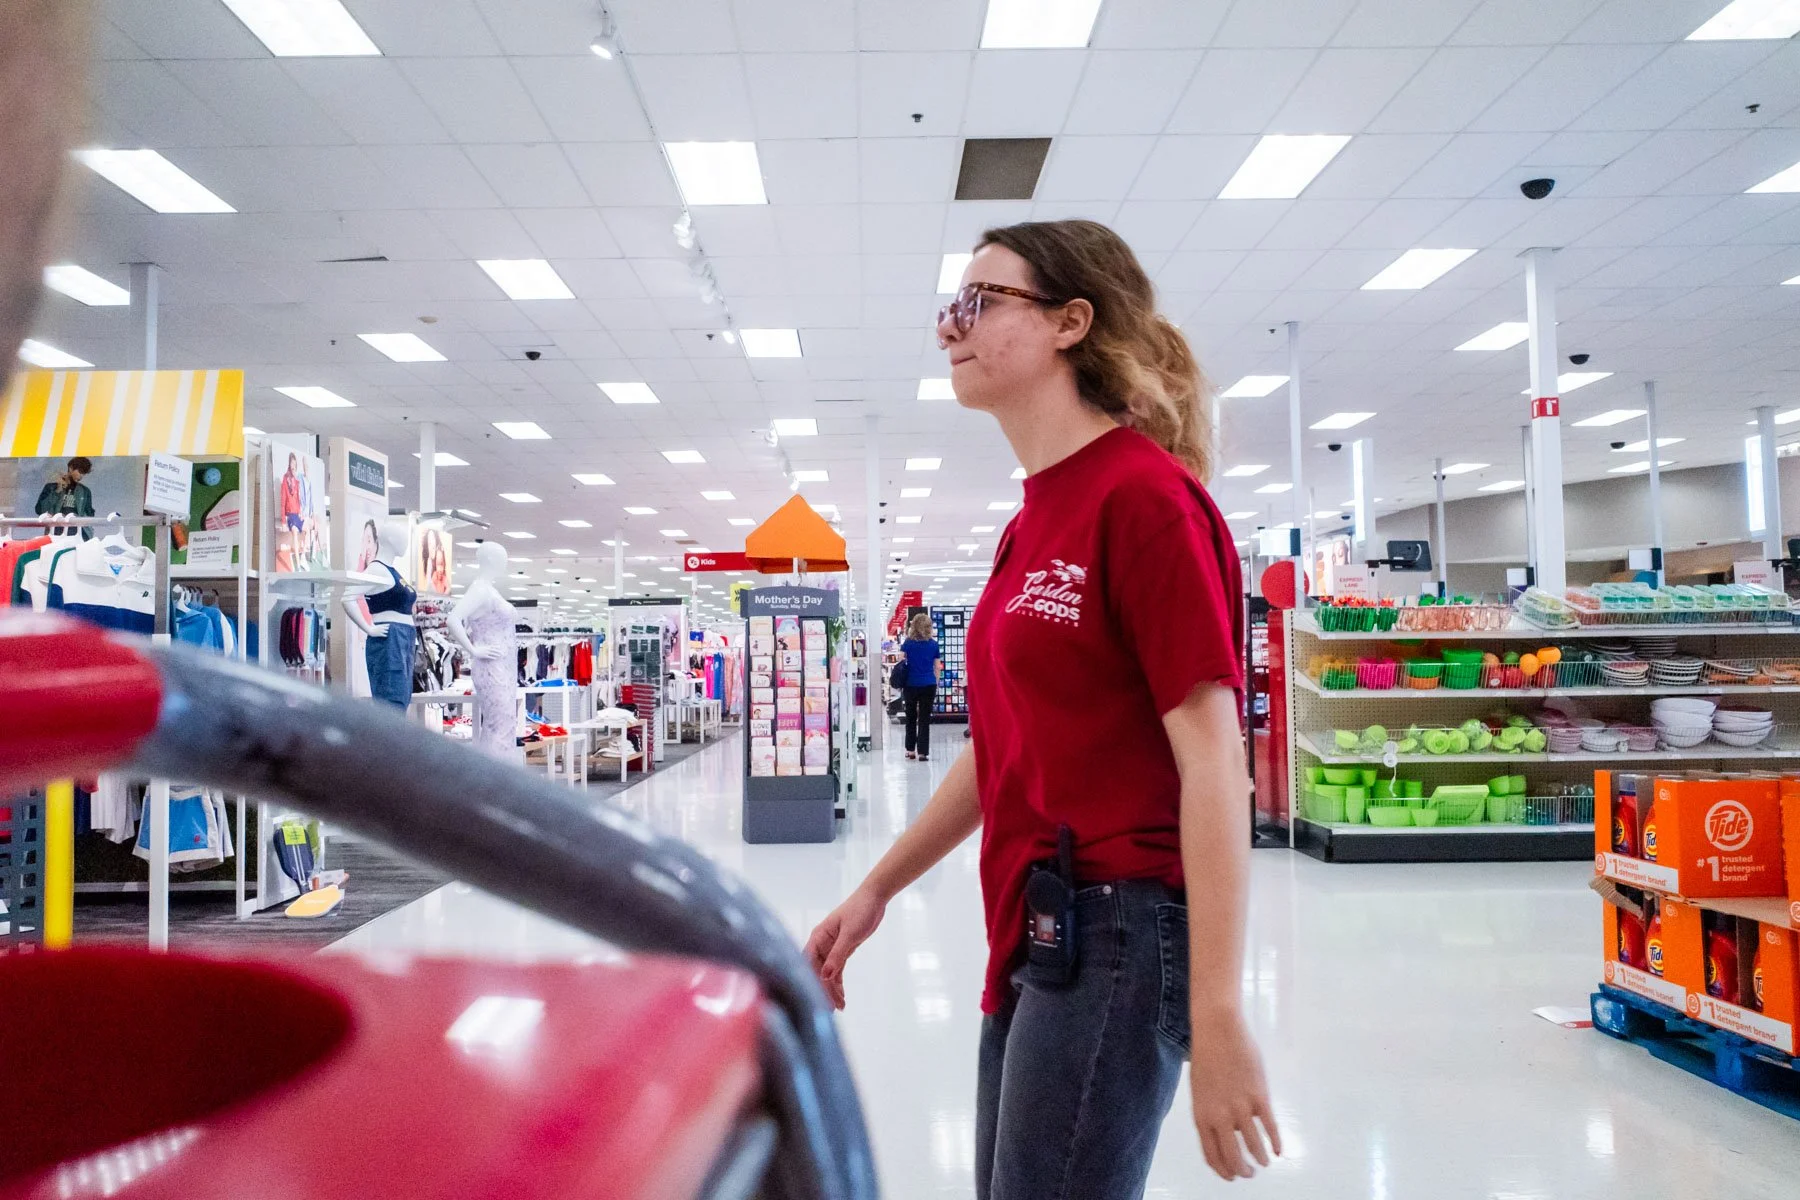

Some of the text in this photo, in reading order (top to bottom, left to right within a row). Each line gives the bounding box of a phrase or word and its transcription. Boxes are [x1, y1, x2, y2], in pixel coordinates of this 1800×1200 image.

[701, 558, 716, 566] Kids
[1005, 570, 1083, 613] Garden
[754, 595, 823, 605] Mother's Day
[1033, 599, 1080, 620] GODS
[1709, 811, 1750, 843] Tide
[1646, 832, 1657, 848] Tid
[1722, 855, 1753, 863] trusted
[1722, 865, 1765, 873] detergent
[1650, 946, 1663, 962] Tid
[1716, 1003, 1741, 1019] trusted
[1717, 1015, 1752, 1033] detergent
